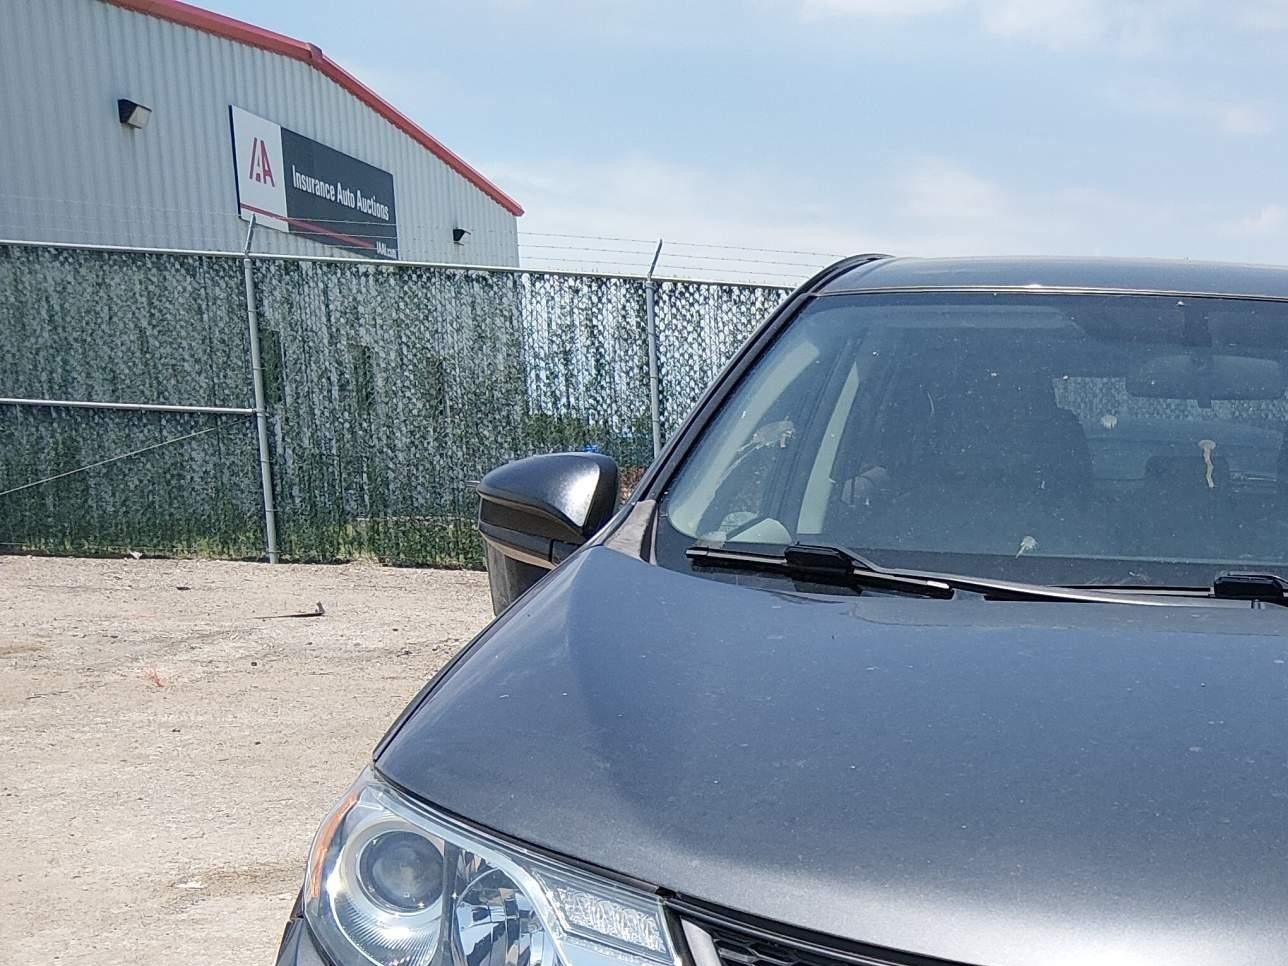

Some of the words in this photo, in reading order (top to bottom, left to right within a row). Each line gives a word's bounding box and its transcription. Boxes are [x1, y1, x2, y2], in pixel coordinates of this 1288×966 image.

[292, 164, 336, 202] Insurance
[337, 181, 356, 209] Auto
[356, 189, 390, 221] Auctions
